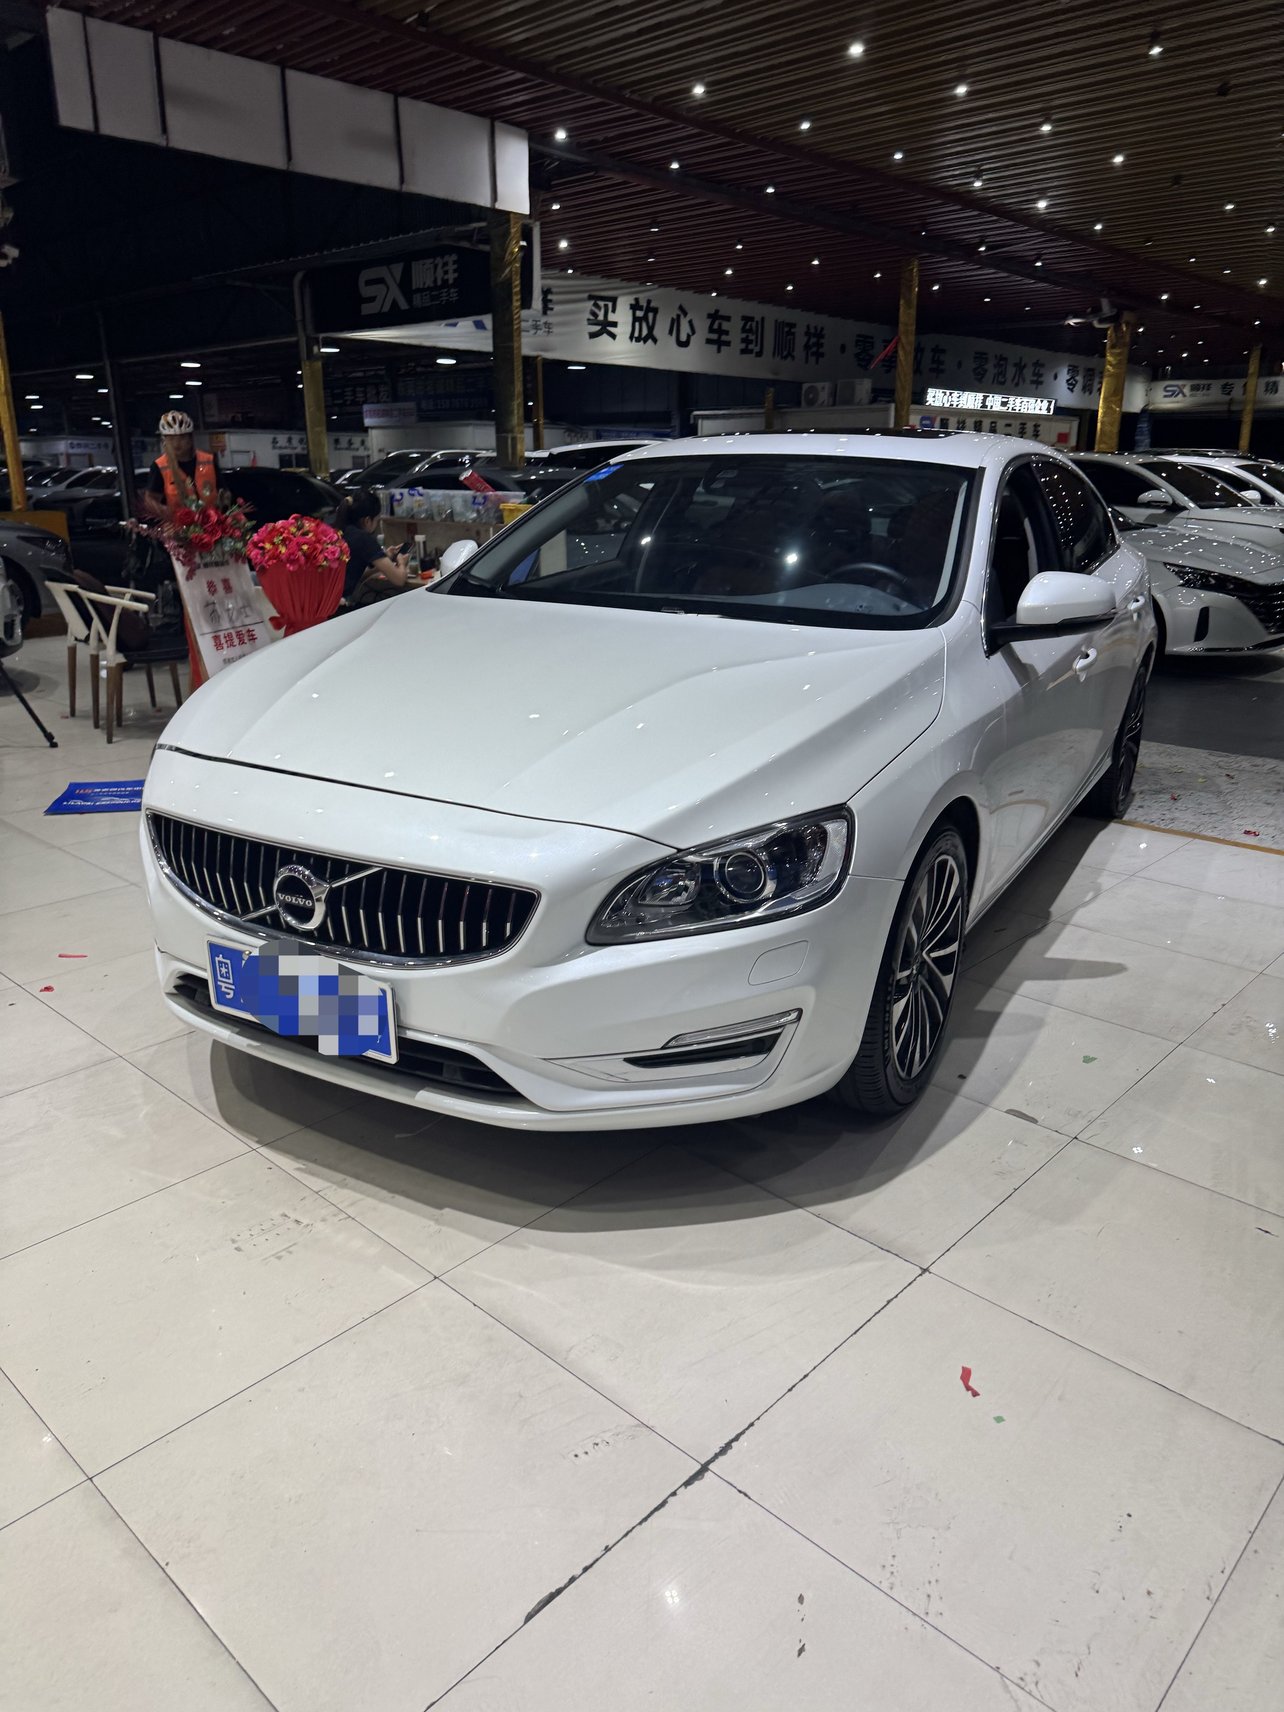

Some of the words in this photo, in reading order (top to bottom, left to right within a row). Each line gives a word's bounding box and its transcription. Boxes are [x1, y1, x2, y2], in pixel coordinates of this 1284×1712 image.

[412, 253, 459, 290] 顺祥
[358, 262, 410, 316] SX
[586, 293, 826, 365] 买放心车到顺祥
[972, 351, 1046, 390] 零泡水车
[1163, 383, 1187, 399] SX
[211, 628, 258, 652] 喜提爱车
[277, 892, 314, 908] VOLVO
